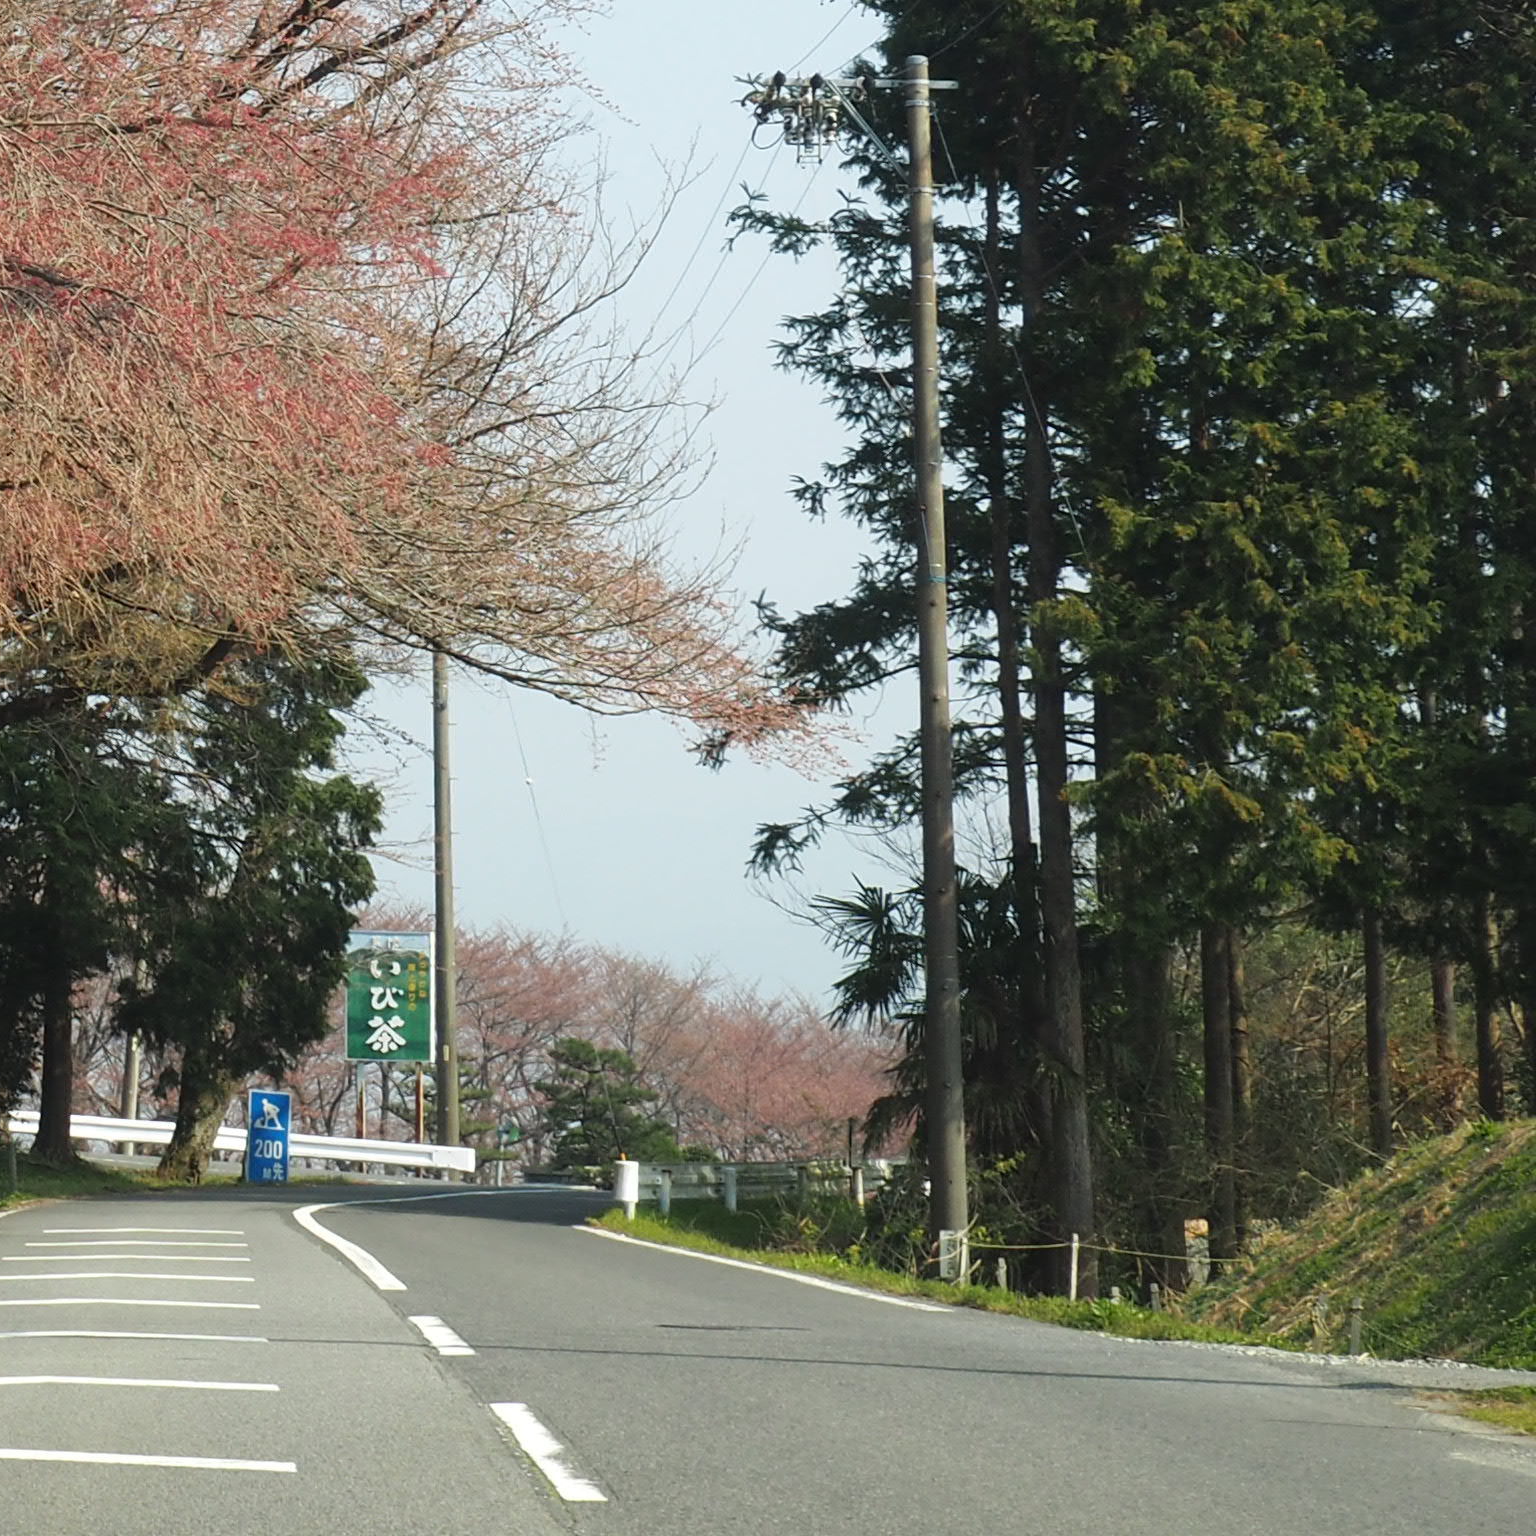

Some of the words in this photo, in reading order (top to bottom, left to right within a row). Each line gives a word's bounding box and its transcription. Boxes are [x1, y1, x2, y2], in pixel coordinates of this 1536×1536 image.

[365, 960, 407, 1054] いび茶
[254, 1139, 283, 1159] 200
